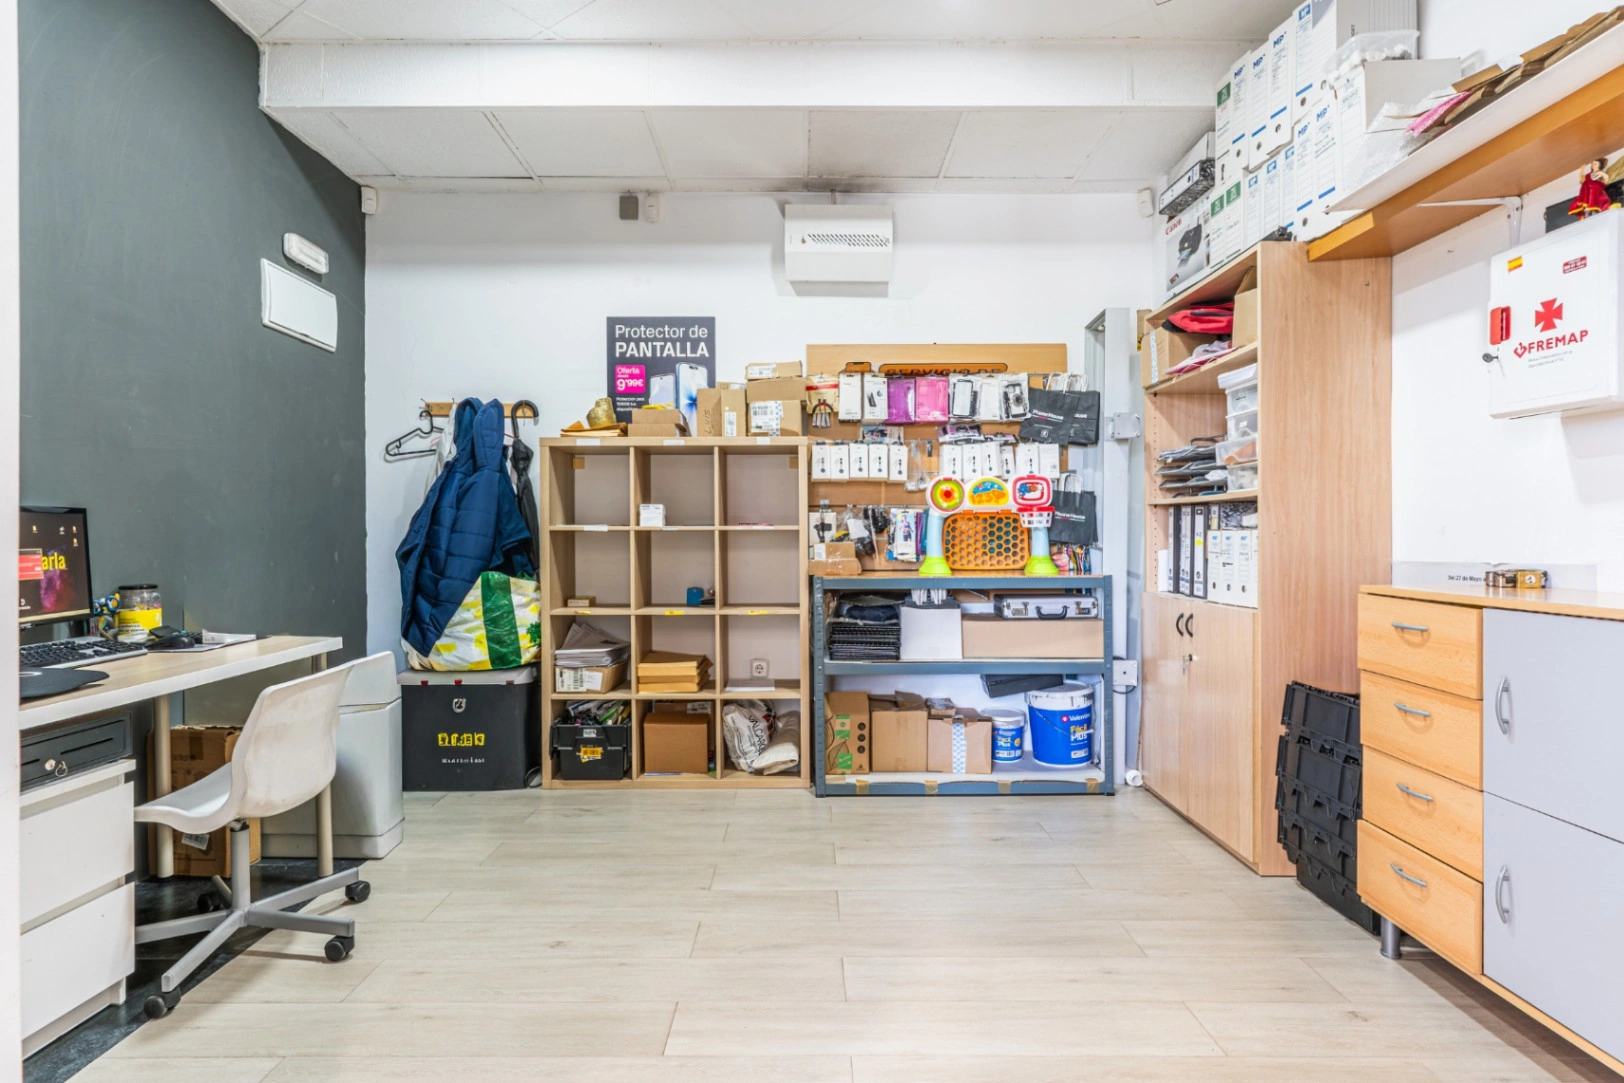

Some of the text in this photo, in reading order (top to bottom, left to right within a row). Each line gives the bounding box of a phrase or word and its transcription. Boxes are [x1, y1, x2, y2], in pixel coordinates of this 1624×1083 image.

[615, 324, 708, 338] Protector de
[615, 341, 709, 357] PANTALLA
[1528, 329, 1589, 354] FREMAP
[41, 552, 66, 570] arla
